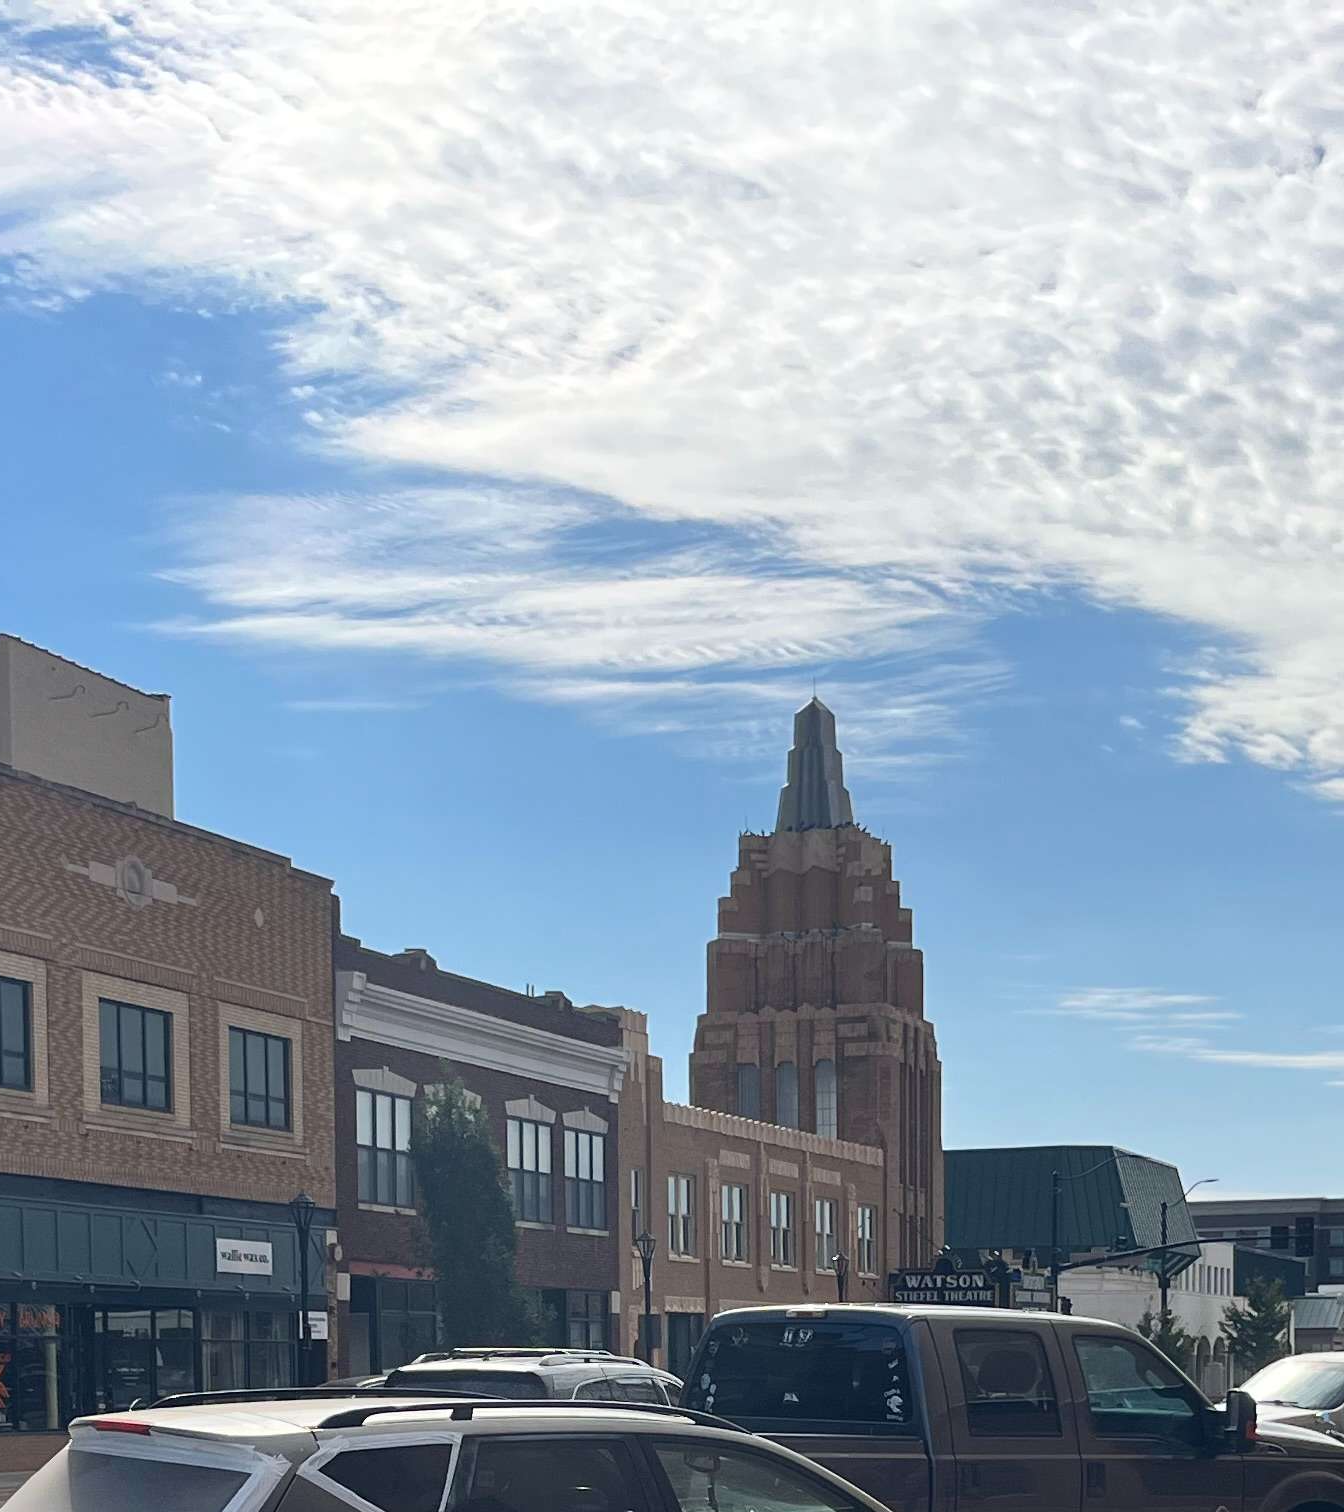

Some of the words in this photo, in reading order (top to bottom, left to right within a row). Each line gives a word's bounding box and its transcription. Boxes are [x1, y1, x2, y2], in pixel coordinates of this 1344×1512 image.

[905, 1274, 984, 1288] WATSON
[895, 1290, 938, 1302] STIEFEL
[943, 1290, 995, 1302] THEATRE
